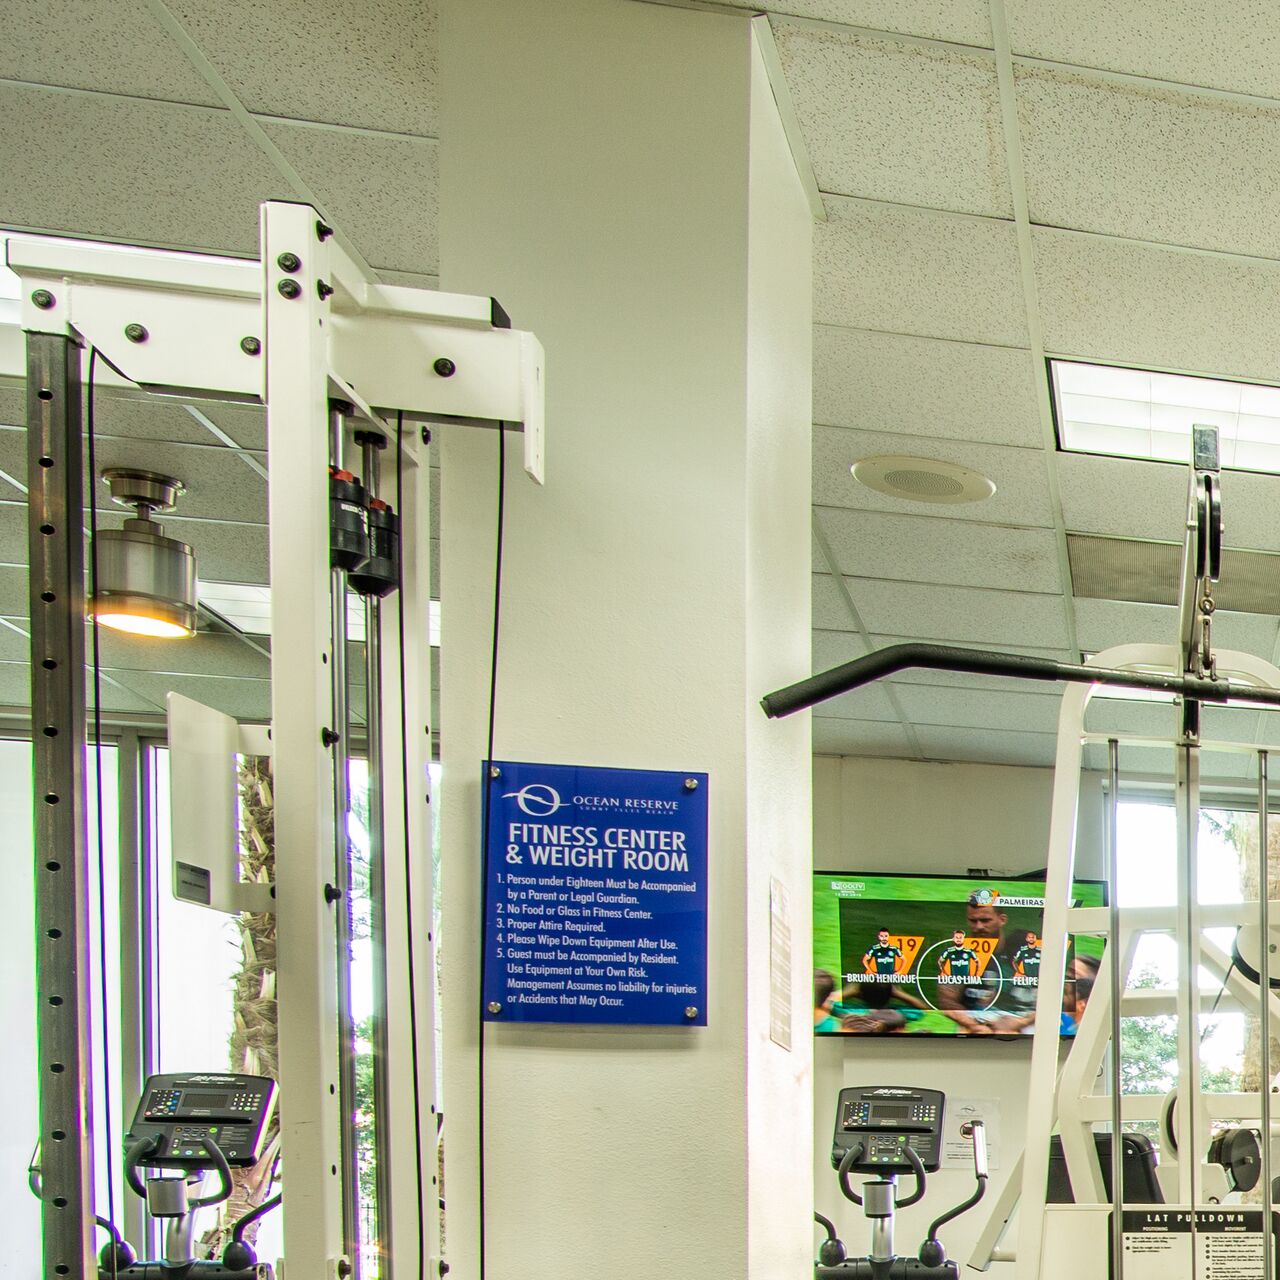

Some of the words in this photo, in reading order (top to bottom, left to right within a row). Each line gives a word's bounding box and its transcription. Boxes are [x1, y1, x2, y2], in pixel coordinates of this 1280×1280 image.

[573, 796, 620, 807] OCEAN
[625, 799, 678, 810] RESERVE
[509, 823, 598, 847] FITNESS
[604, 828, 687, 851] CENTER
[505, 844, 523, 865] &
[528, 846, 618, 869] WEIGHT
[623, 850, 689, 872] ROOM
[496, 873, 505, 884] 1.
[506, 874, 537, 885] Person
[538, 876, 565, 887] under
[566, 877, 605, 890] Eighteen
[605, 879, 627, 889] Must
[628, 879, 640, 890] be
[640, 880, 697, 894] Accompanied
[507, 888, 519, 902] by
[519, 892, 527, 900] a
[528, 890, 558, 901] Parent
[558, 894, 569, 902] or
[570, 892, 595, 905] Legal
[596, 893, 640, 905] Guardian.
[999, 898, 1044, 906] PALMEIRAS
[496, 903, 505, 914] 2.
[507, 904, 521, 914] No
[521, 904, 544, 915] Food
[545, 908, 556, 916] or
[557, 906, 581, 917] Glass
[582, 907, 591, 917] in
[593, 907, 623, 919] Fitness
[623, 908, 653, 920] Center.
[496, 918, 505, 929] 3.
[507, 919, 537, 932] Proper
[538, 920, 563, 931] Attire
[564, 921, 606, 934] Required.
[496, 933, 506, 944] 4.
[507, 933, 536, 945] Please
[537, 935, 561, 948] Wipe
[562, 936, 588, 947] Down
[589, 937, 636, 950] Equipment
[637, 938, 659, 949] After
[660, 939, 679, 950] Use.
[897, 939, 916, 951] 19
[971, 941, 990, 953] 20
[496, 948, 505, 958] 5.
[507, 948, 533, 959] Guest
[533, 952, 556, 960] must
[557, 950, 569, 961] be
[569, 951, 627, 964] Accompanied
[628, 952, 640, 965] by
[640, 953, 679, 965] Resident.
[507, 963, 524, 974] Use
[525, 964, 573, 977] Equipment
[574, 967, 584, 976] at
[584, 966, 605, 977] Your
[606, 967, 626, 977] Own
[628, 967, 649, 978] Risk.
[847, 974, 874, 983] BRUNO
[877, 974, 916, 984] HENRIQUE
[938, 975, 962, 984] LUCAS
[964, 976, 982, 984] LIMA
[1013, 977, 1037, 985] FELIPE
[506, 978, 565, 992] Management
[566, 980, 604, 991] Assumes
[605, 984, 617, 992] no
[618, 981, 651, 995] liability
[651, 982, 665, 993] for
[665, 984, 698, 996] injuries
[518, 994, 559, 1005] Accidents
[559, 995, 578, 1005] that
[578, 995, 598, 1008] May
[599, 996, 624, 1007] Occur.
[1177, 1214, 1244, 1222] PULLDOWN
